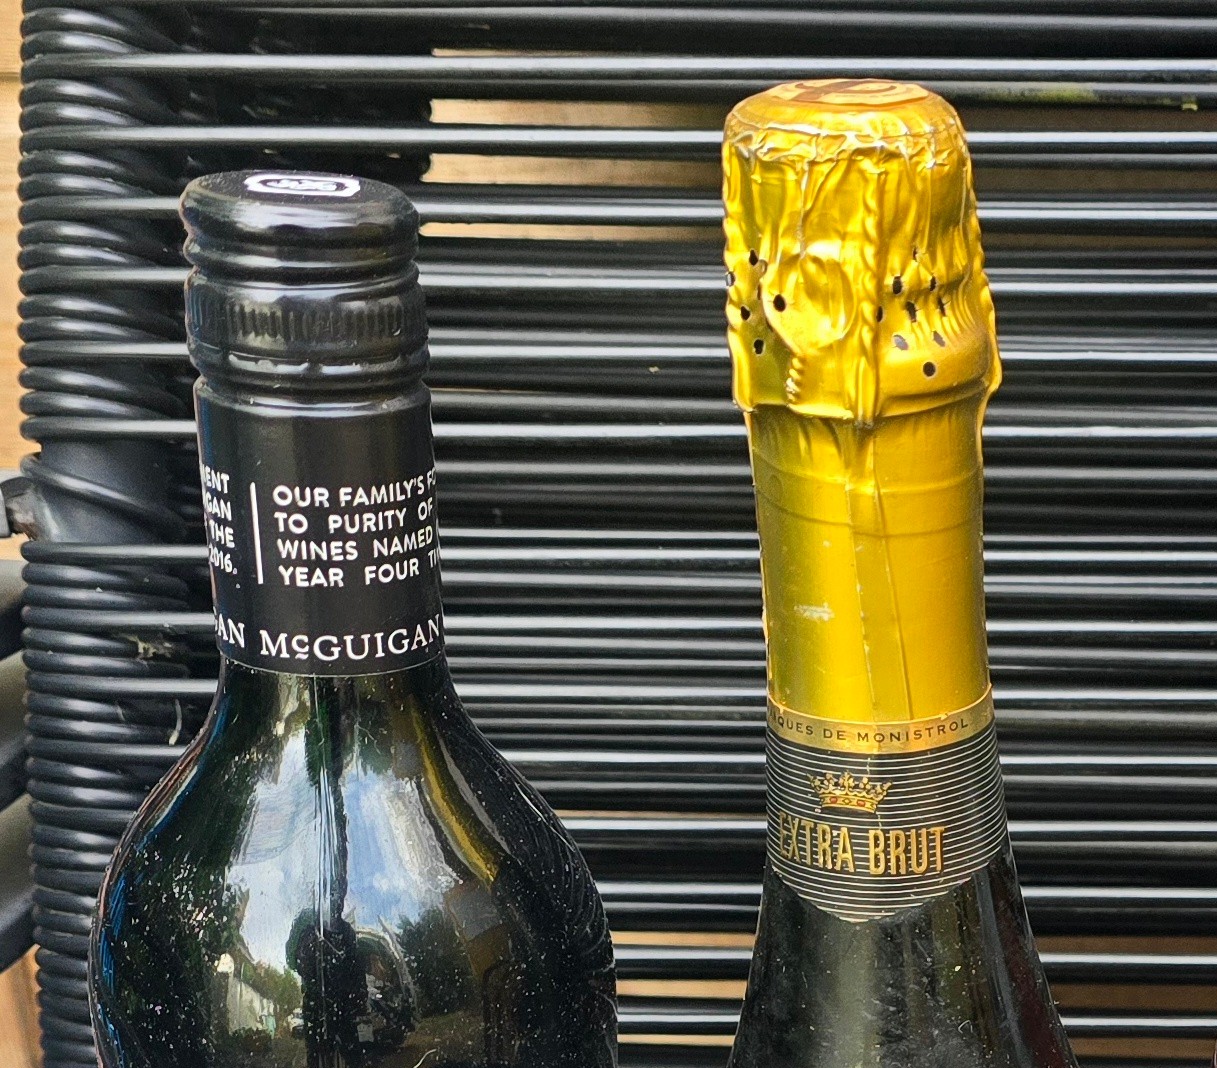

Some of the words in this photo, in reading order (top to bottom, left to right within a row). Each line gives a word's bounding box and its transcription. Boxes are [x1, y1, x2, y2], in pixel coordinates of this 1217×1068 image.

[273, 485, 329, 507] OUR
[339, 475, 424, 506] FAMILY'S
[274, 511, 308, 534] TO
[328, 508, 406, 533] PURITY
[418, 497, 433, 520] OF
[209, 519, 235, 548] THE
[277, 539, 358, 561] WINES
[373, 525, 433, 558] NAMED
[278, 565, 344, 587] YEAR
[364, 558, 419, 585] FOUR
[260, 613, 441, 661] McGUIGAN
[823, 729, 846, 740] DE
[857, 718, 968, 743] MONISTROL
[779, 811, 855, 873] EXTRA
[868, 825, 945, 875] BRUT
